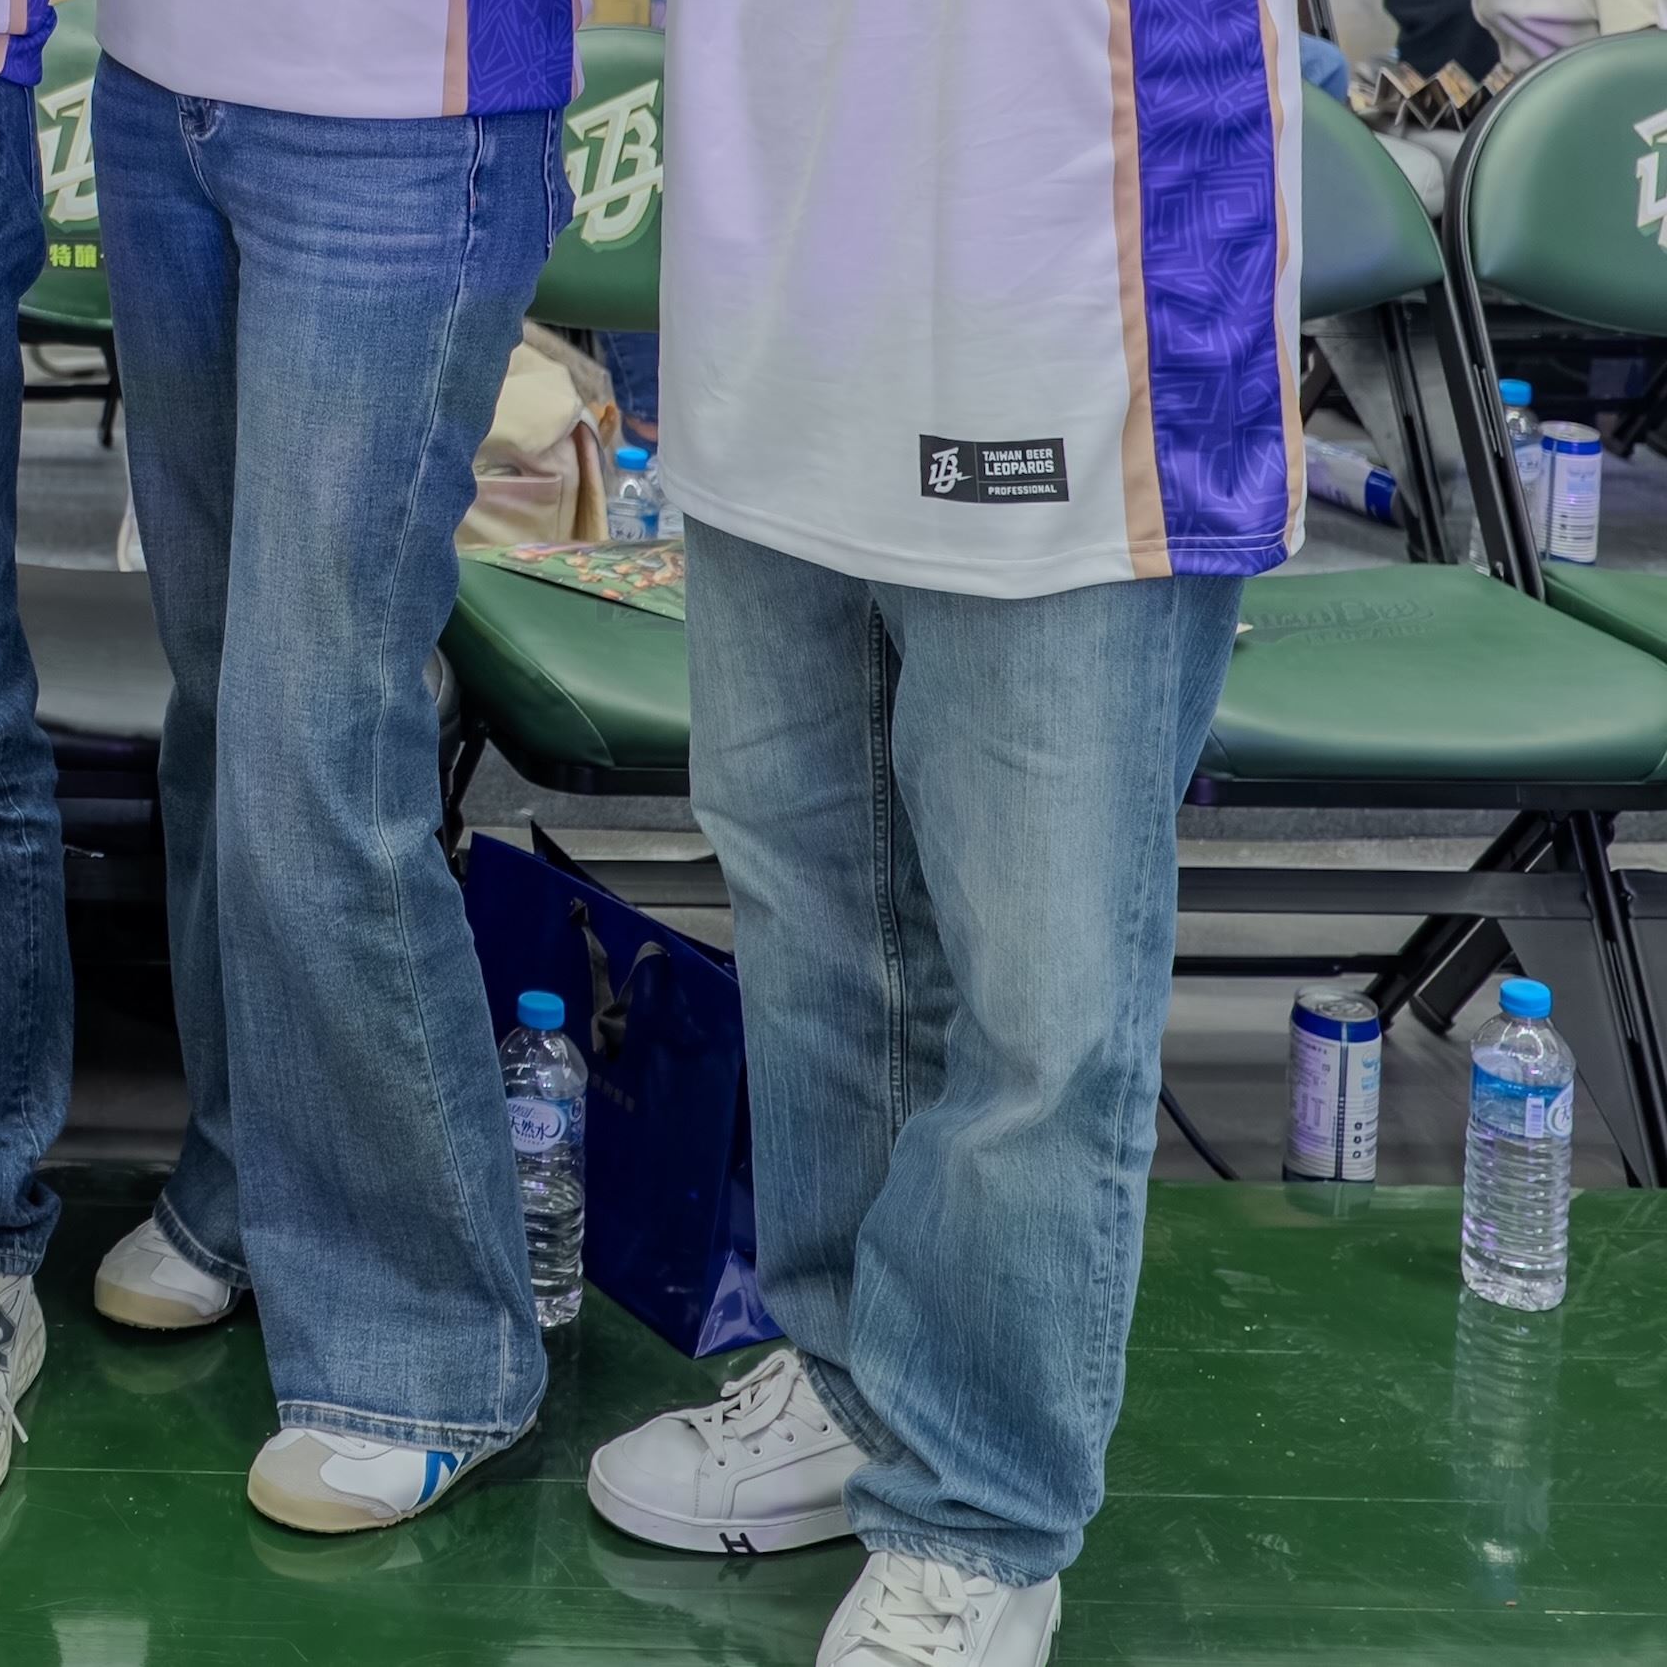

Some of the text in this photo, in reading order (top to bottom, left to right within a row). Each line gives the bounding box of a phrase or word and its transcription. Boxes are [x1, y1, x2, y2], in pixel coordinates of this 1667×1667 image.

[982, 448, 1054, 462] TAIWAN BEER
[985, 460, 1055, 476] LEOPARDS
[987, 484, 1058, 496] PROFESSIONAL
